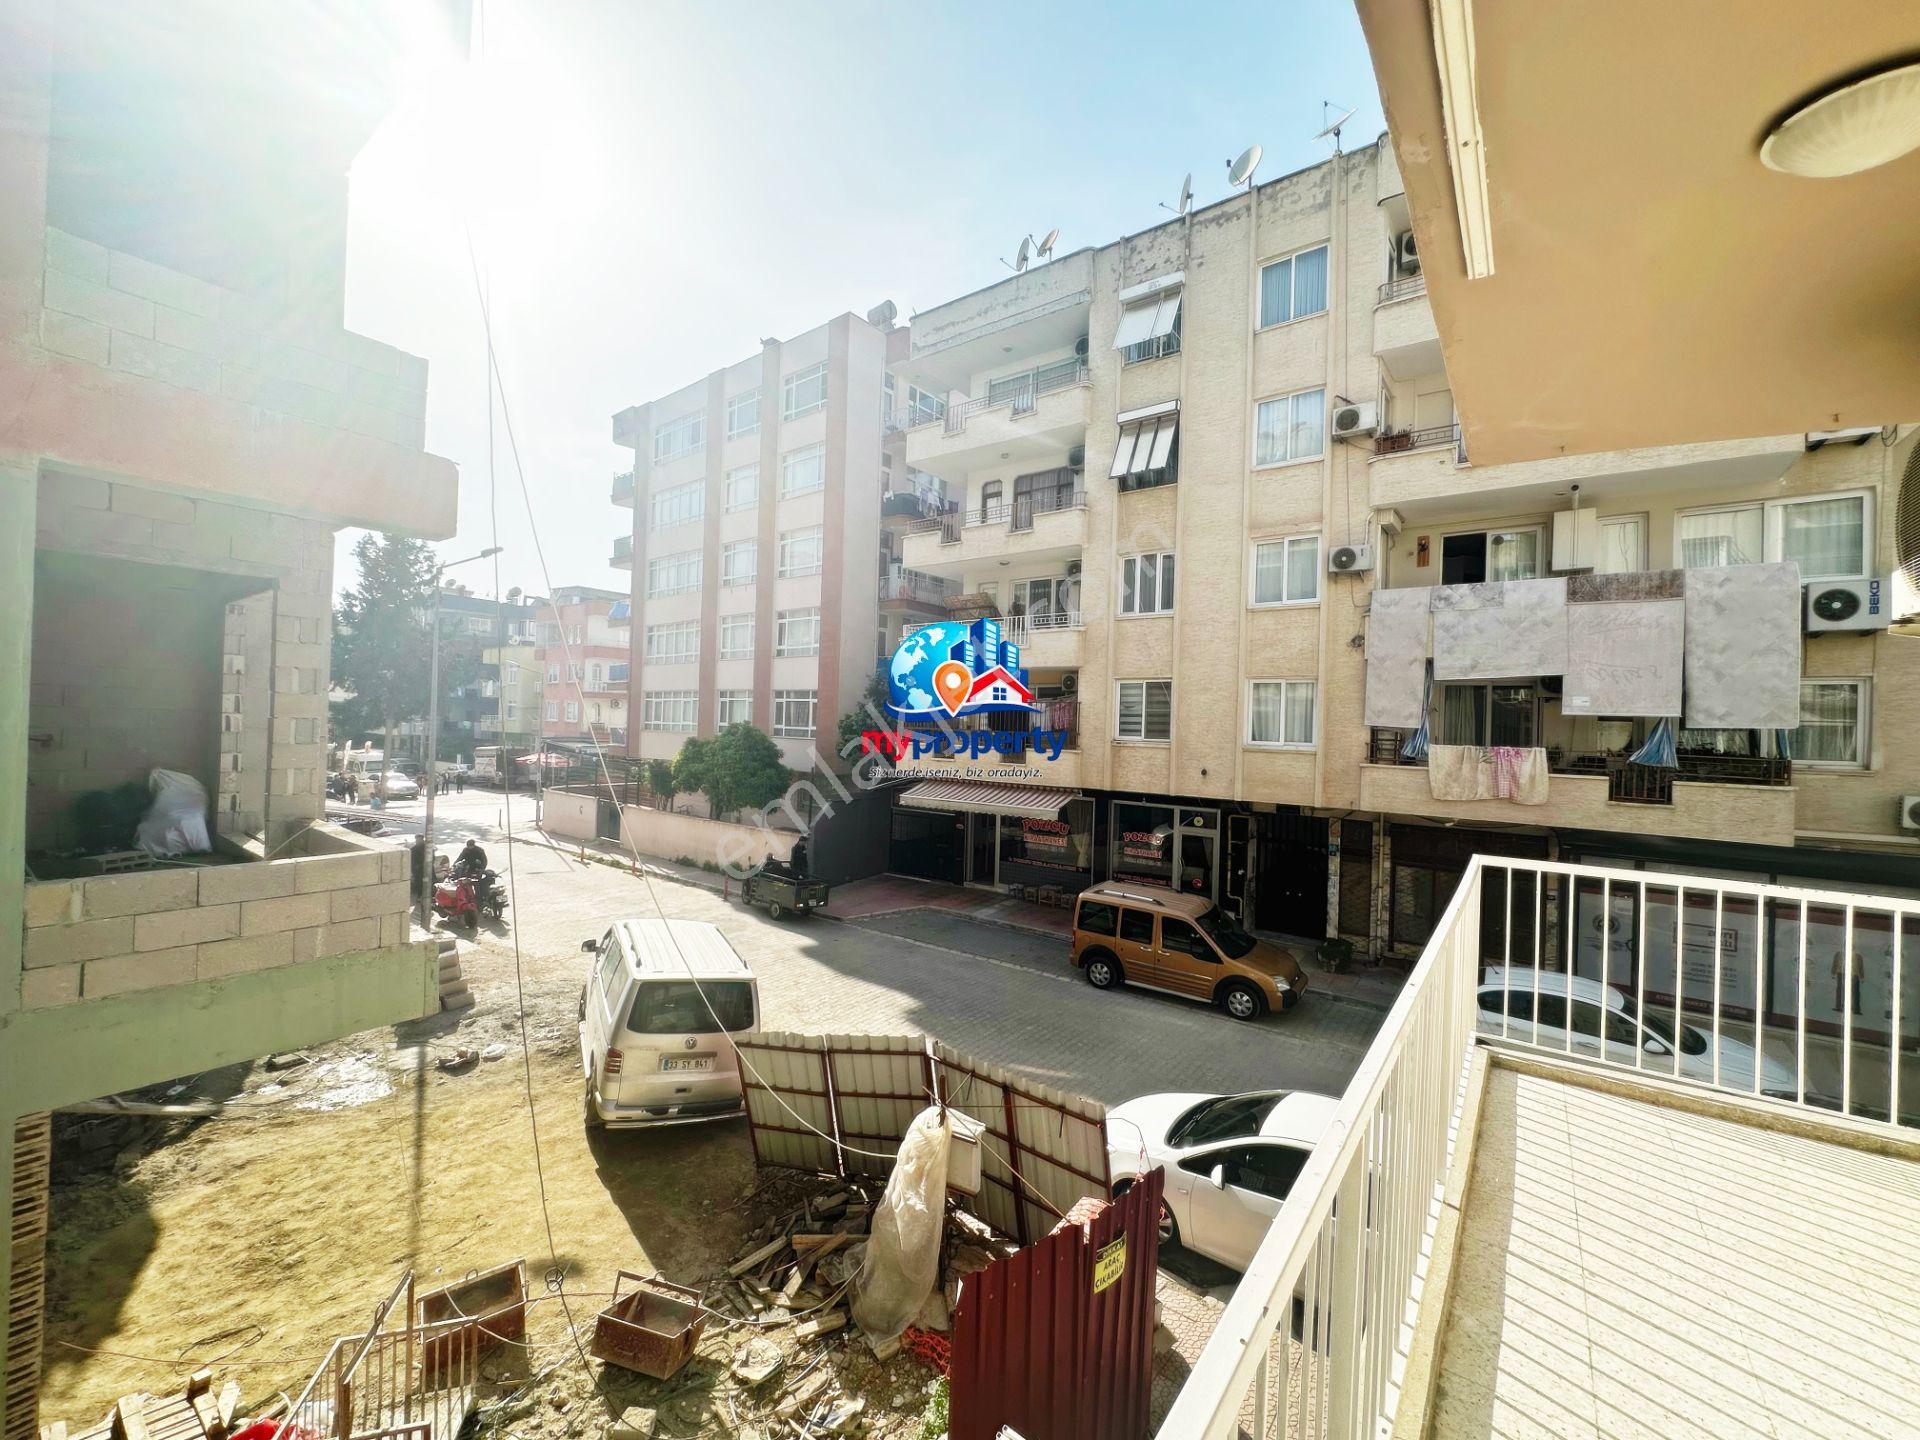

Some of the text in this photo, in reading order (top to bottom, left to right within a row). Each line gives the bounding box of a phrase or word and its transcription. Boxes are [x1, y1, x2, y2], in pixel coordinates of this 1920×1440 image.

[1869, 580, 1880, 615] BEKO
[1022, 818, 1071, 835] POZCU
[669, 1060, 677, 1069] 33
